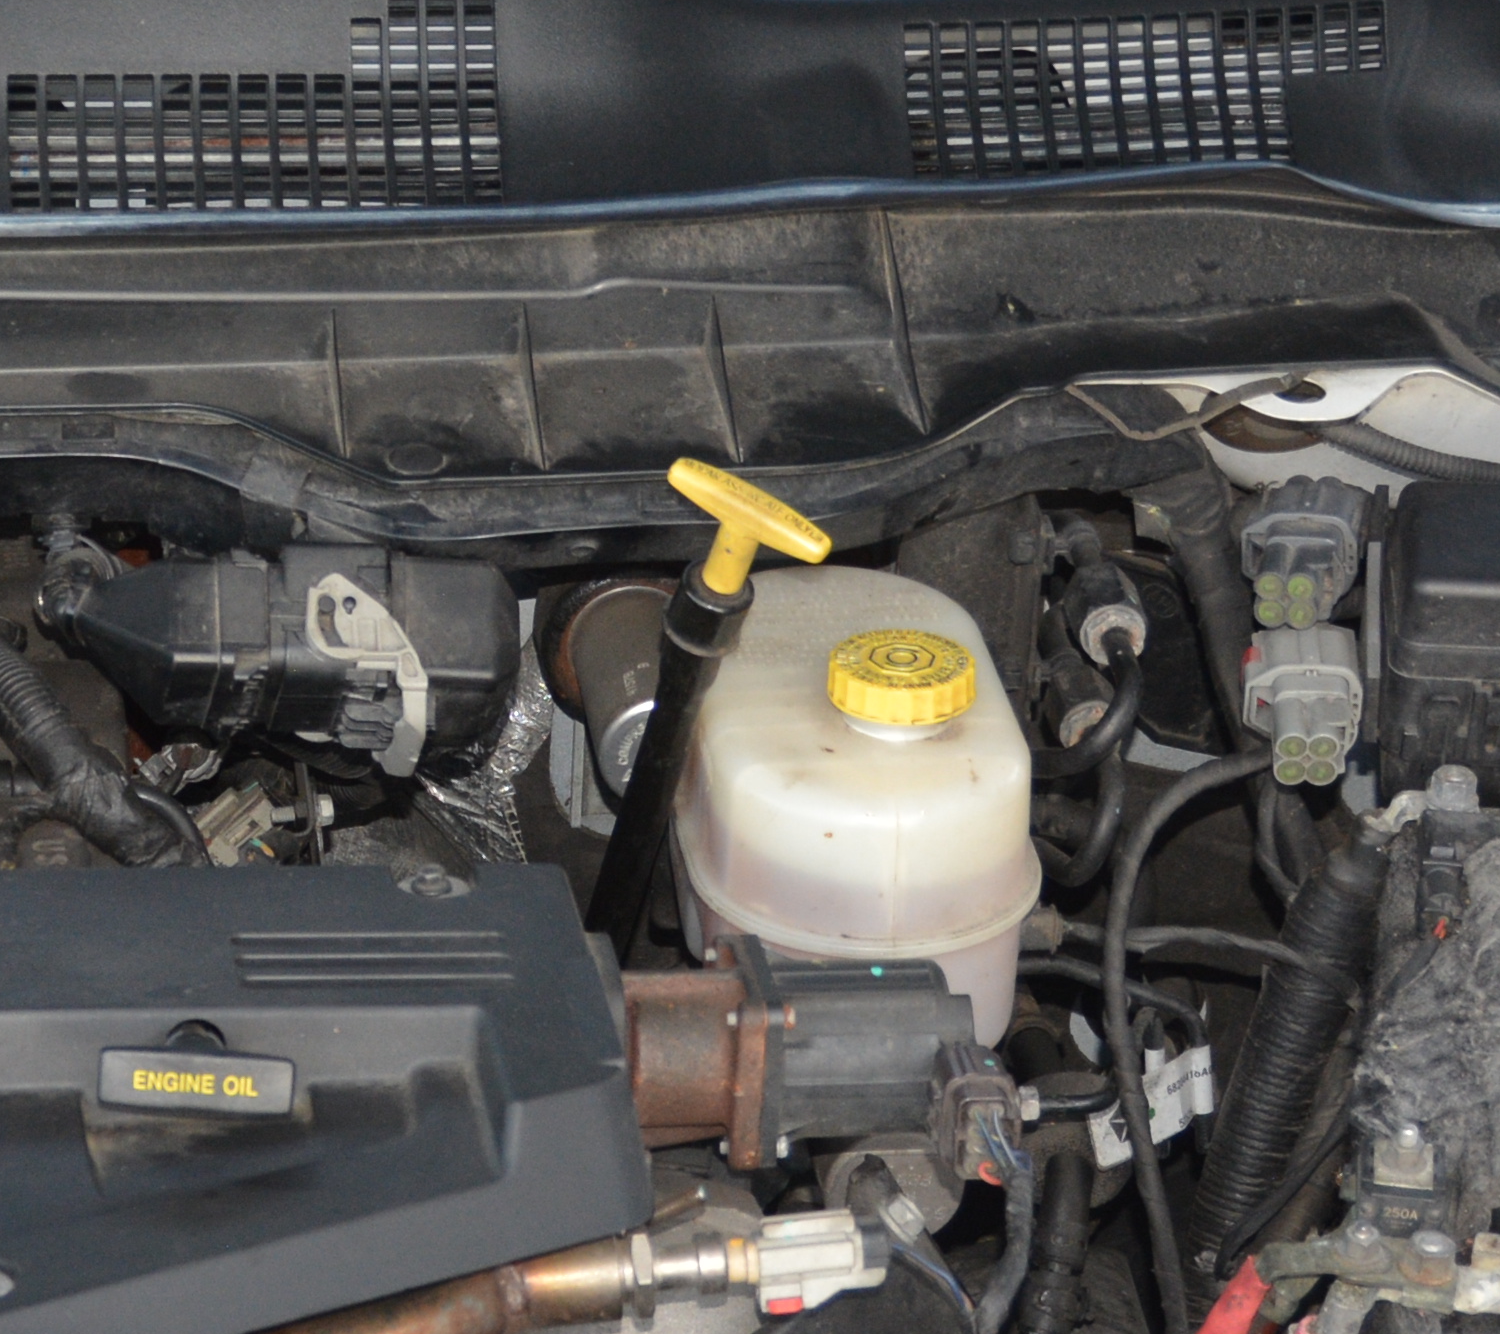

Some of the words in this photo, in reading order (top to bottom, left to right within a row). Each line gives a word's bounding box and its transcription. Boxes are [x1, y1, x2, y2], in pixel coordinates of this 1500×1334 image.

[132, 1069, 216, 1095] ENGINE
[222, 1075, 259, 1098] OIL
[1383, 1207, 1418, 1221] 250A
